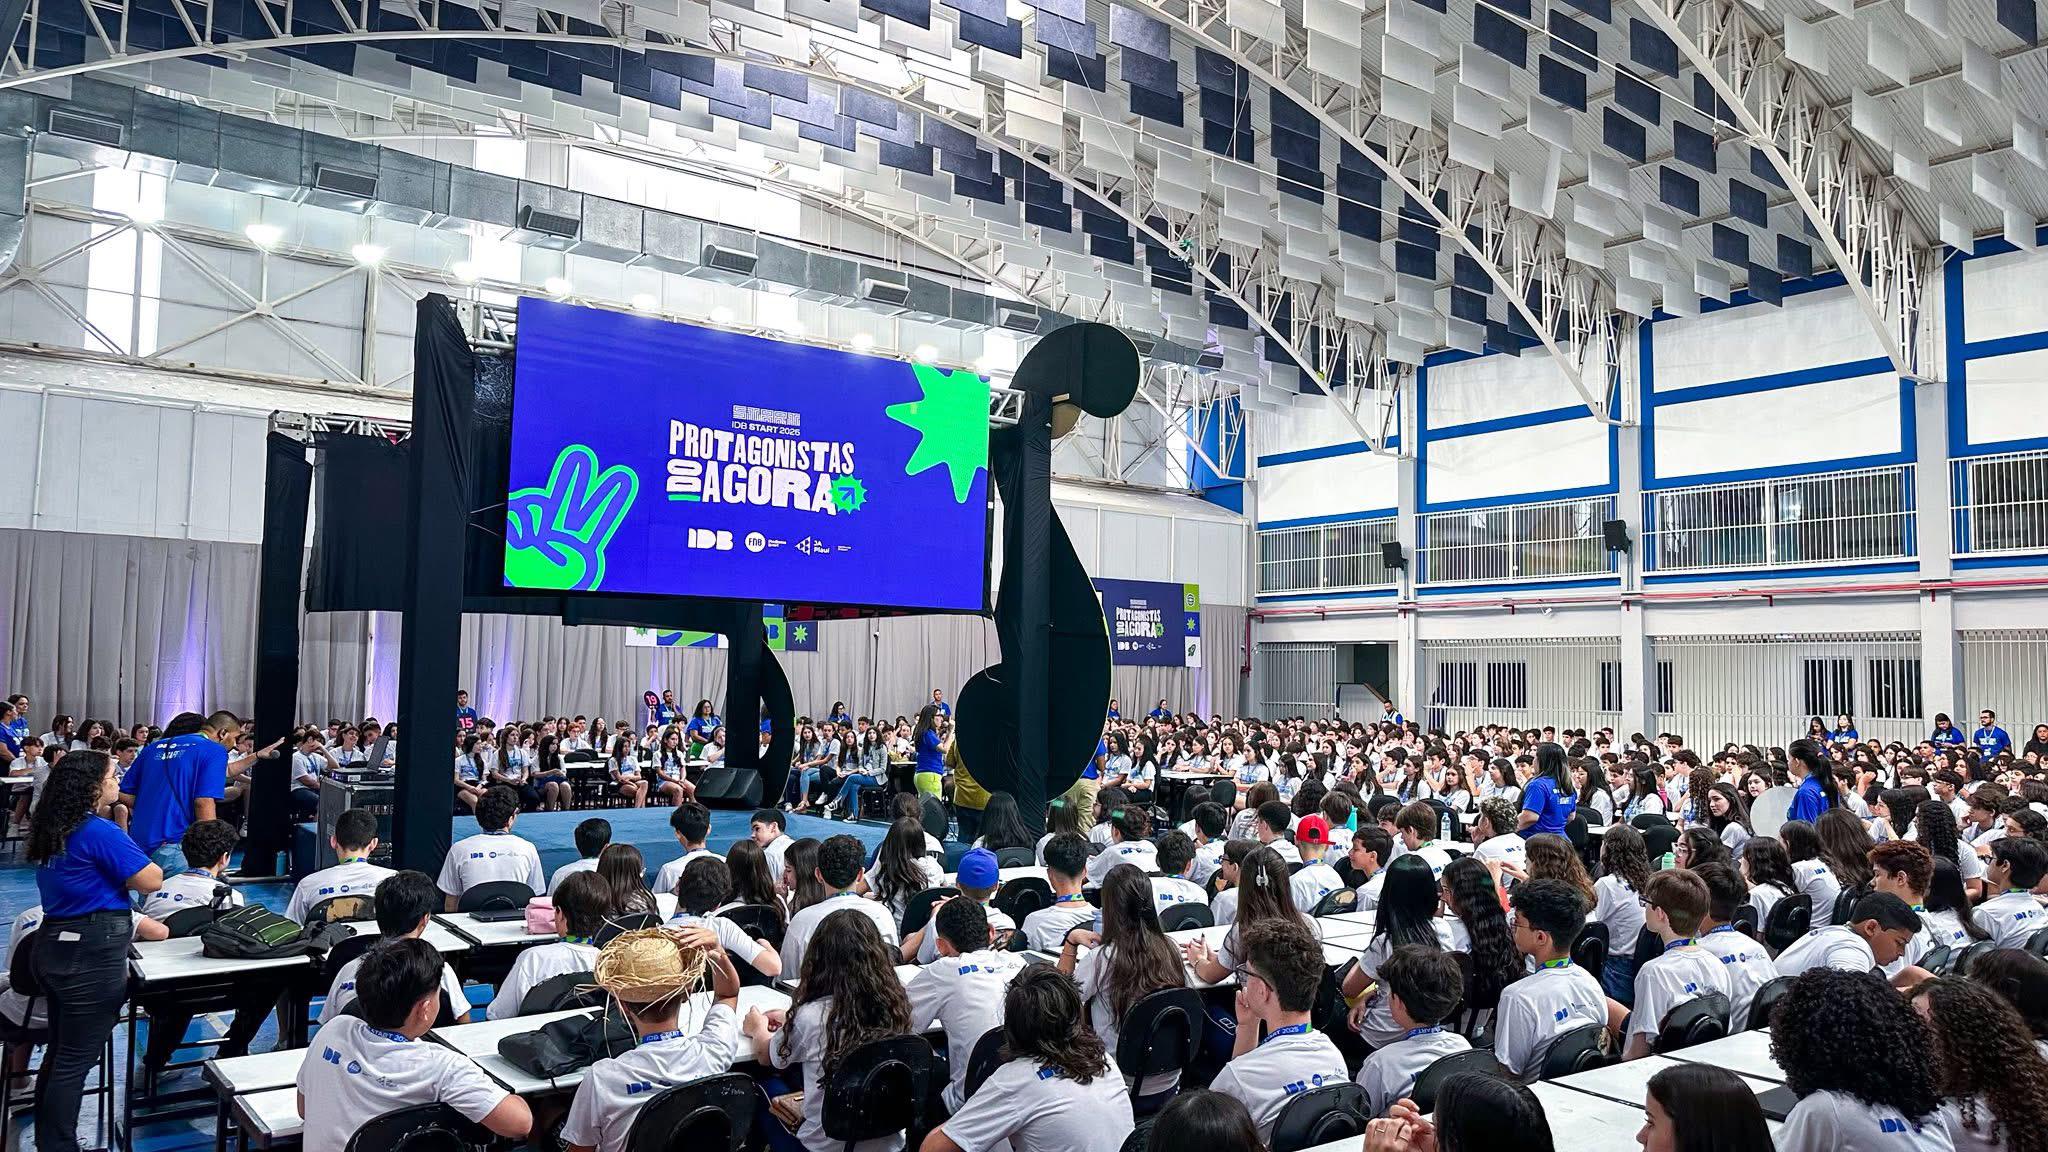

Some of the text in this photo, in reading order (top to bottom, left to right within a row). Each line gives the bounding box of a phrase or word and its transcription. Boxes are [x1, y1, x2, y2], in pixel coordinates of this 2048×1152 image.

[732, 421, 748, 430] IDB
[748, 423, 779, 434] START
[669, 419, 855, 474] PROTAGONISTAS
[666, 458, 837, 516] DO AGORA
[687, 528, 734, 551] IDB
[1124, 621, 1158, 638] AGORA
[646, 695, 658, 705] 19
[459, 717, 474, 729] 15
[958, 964, 979, 975] IDB
[370, 1029, 393, 1039] START
[322, 1045, 342, 1065] IDB
[625, 1081, 653, 1095] IDB
[1282, 1080, 1308, 1096] IDB
